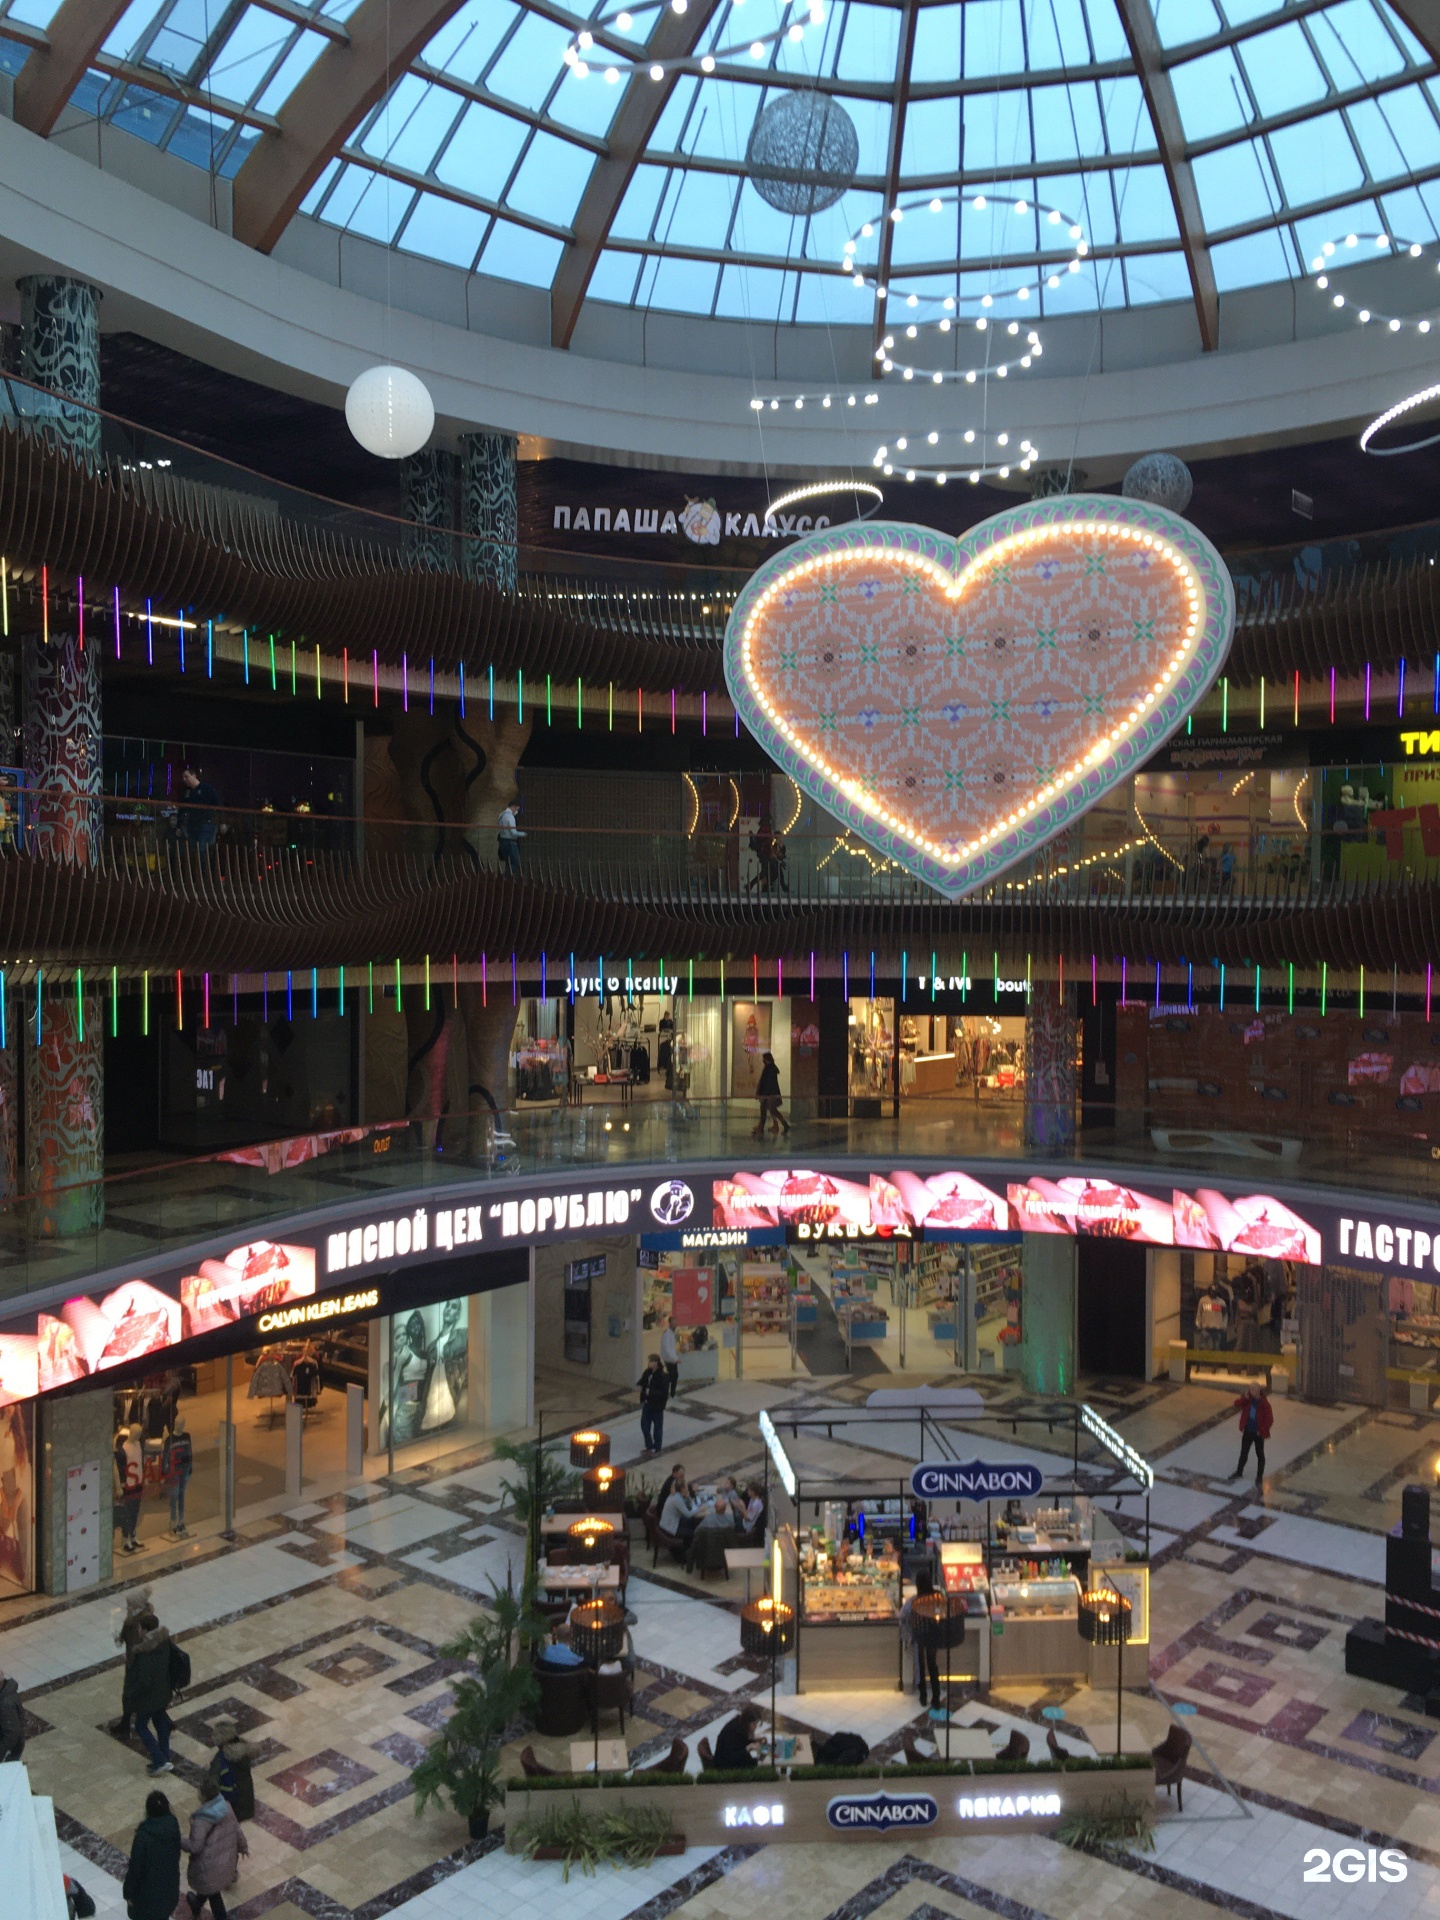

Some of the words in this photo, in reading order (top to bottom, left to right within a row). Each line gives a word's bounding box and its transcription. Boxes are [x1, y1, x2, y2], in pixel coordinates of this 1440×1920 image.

[553, 506, 678, 534] ПАПАША
[1162, 737, 1196, 749] ТСКАЯ
[327, 1207, 428, 1273] МЯСНОЙ
[435, 1205, 483, 1251] ЦЕХ
[682, 1231, 748, 1247] МАГАЗИН
[258, 1307, 305, 1332] CALVIN
[306, 1298, 340, 1321] KLEIN
[341, 1289, 379, 1313] JEANS
[125, 1448, 185, 1491] SALE
[724, 1804, 784, 1827] КАФЕ
[958, 1794, 1061, 1819] ПЕКАРНЯ
